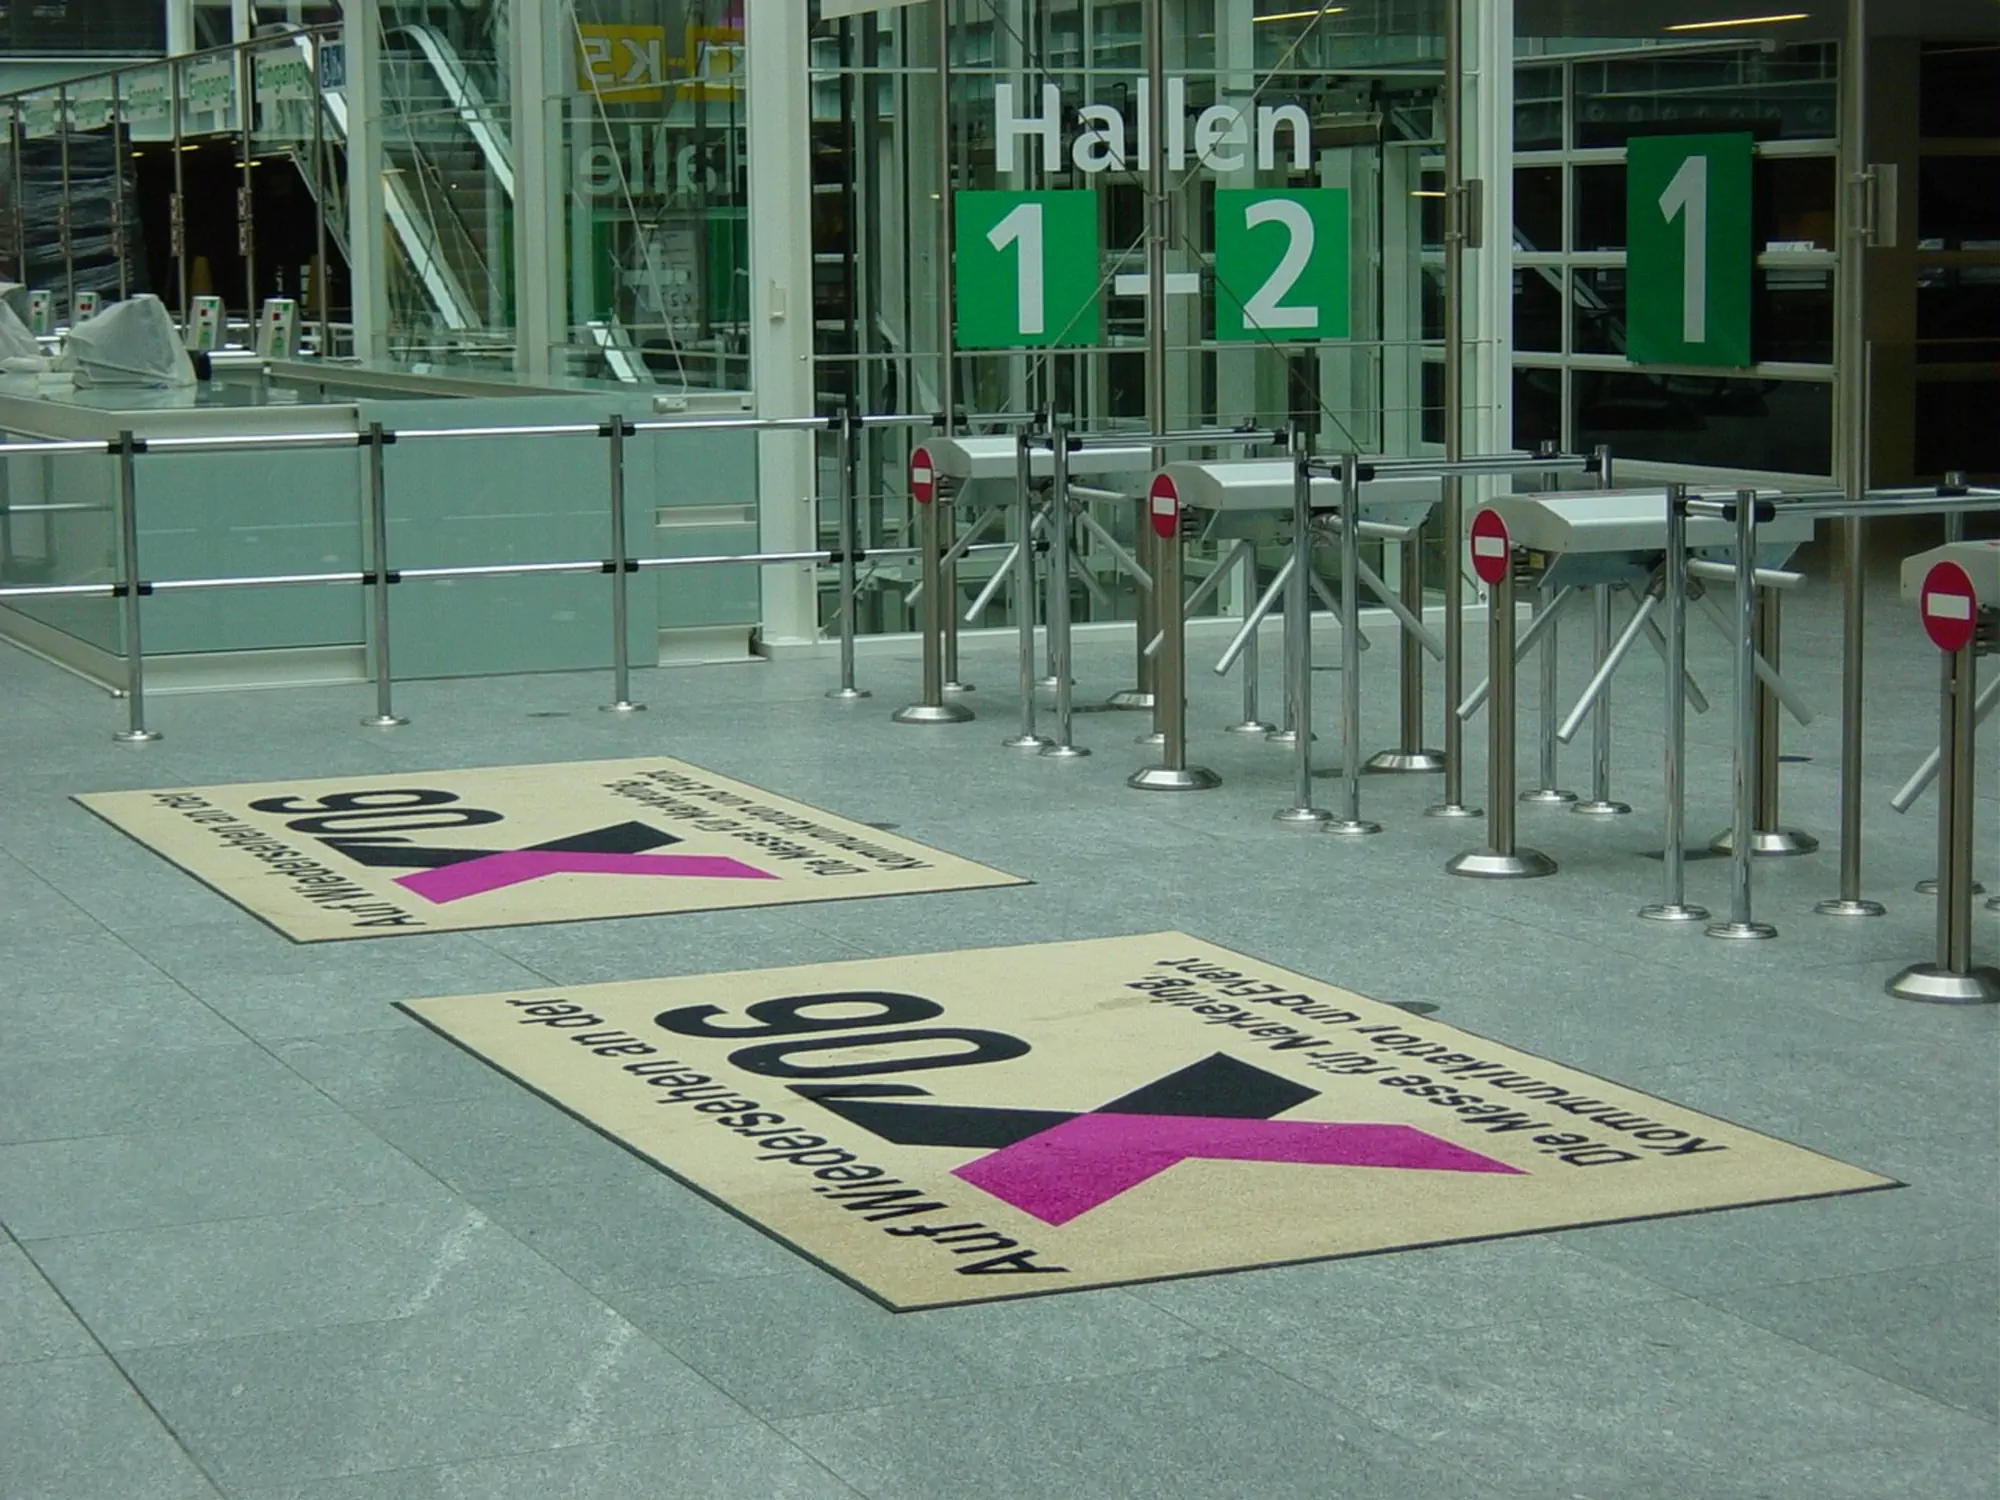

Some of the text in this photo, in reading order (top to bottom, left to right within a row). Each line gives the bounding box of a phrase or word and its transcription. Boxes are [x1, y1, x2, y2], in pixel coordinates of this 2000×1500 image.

[995, 76, 1311, 173] Hallen
[986, 203, 1044, 335] 1
[1242, 199, 1319, 329] 2
[1658, 155, 1707, 343] 1
[207, 825, 375, 903] Wiedersehen
[320, 902, 427, 927] Auf
[1157, 958, 1284, 997] Event
[1251, 994, 1361, 1025] und
[1306, 1052, 1397, 1075] für
[1379, 1075, 1552, 1133] Messe
[506, 999, 1071, 1276] Auf Wiedersehen an der
[1532, 1133, 1641, 1167] Die
